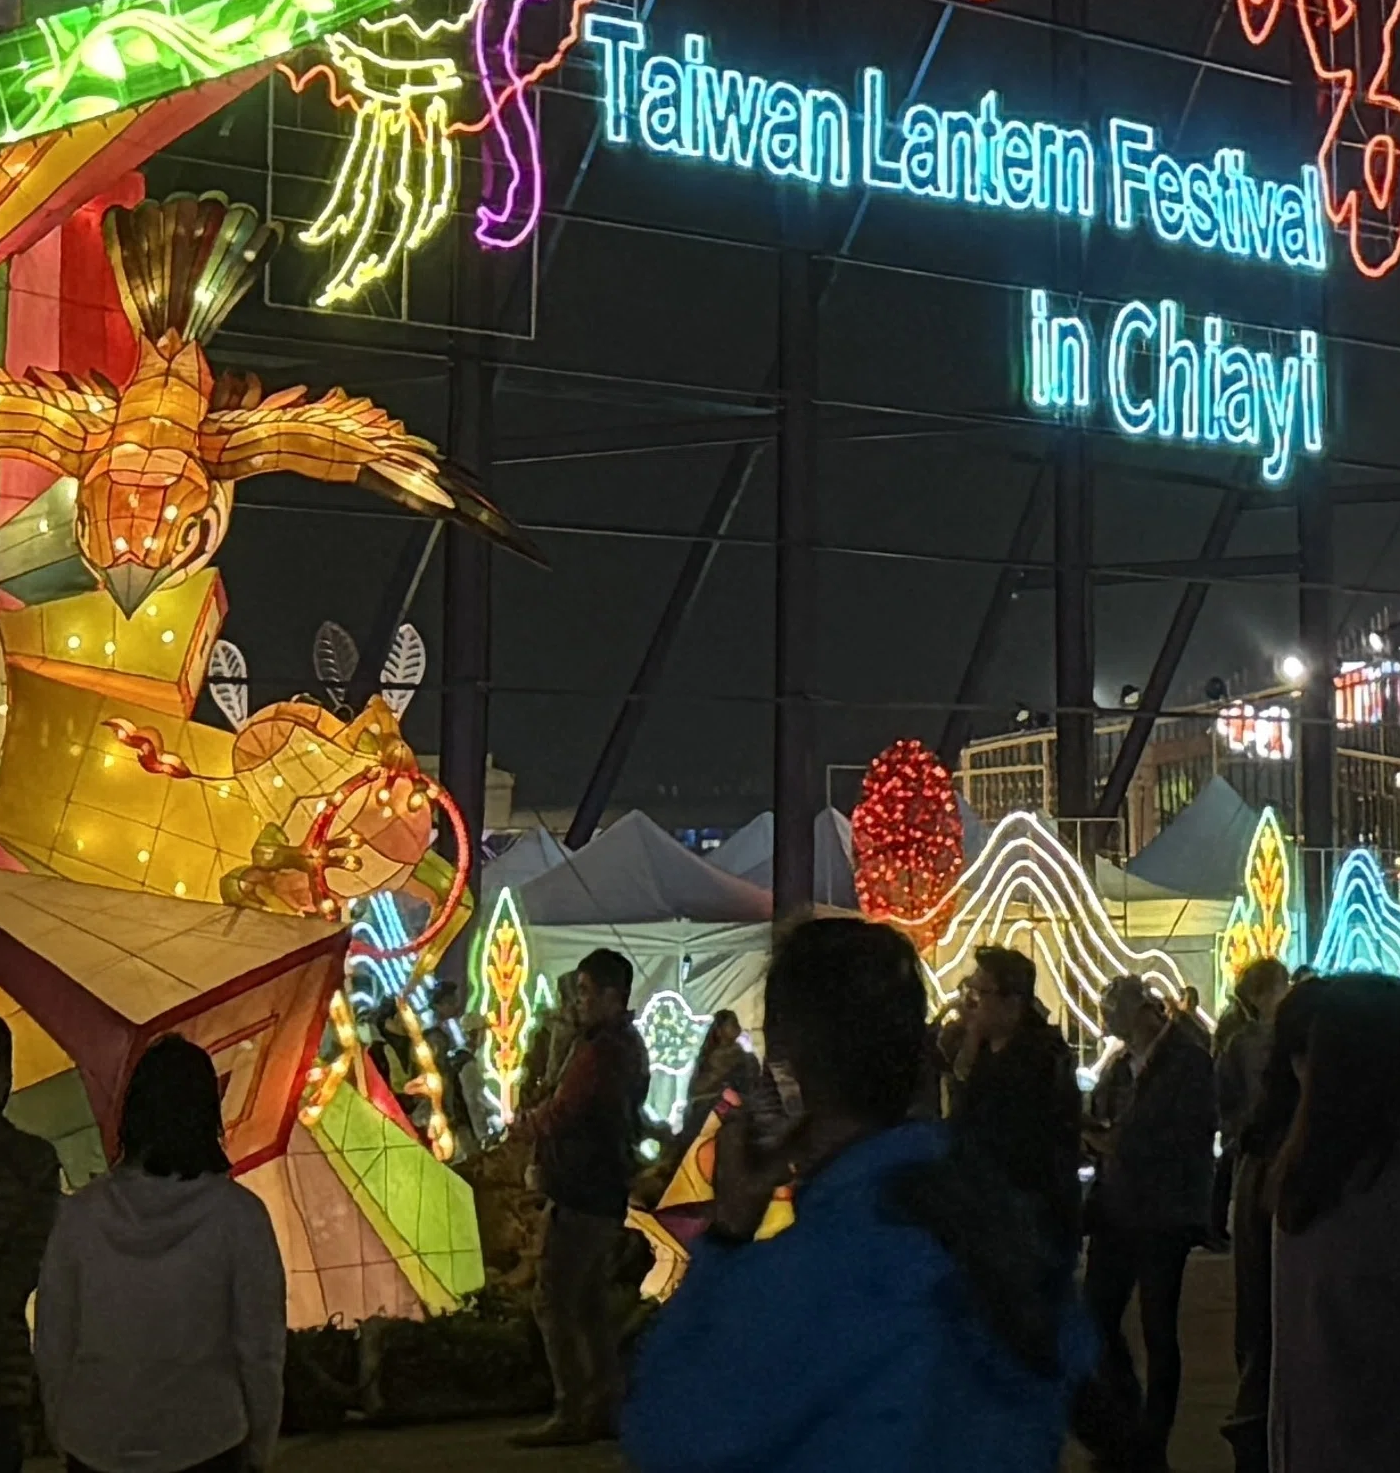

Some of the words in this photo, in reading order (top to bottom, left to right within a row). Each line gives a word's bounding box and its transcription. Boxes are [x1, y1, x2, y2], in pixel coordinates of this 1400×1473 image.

[583, 12, 850, 188] Taiwan
[859, 66, 1096, 218] Lantern
[1108, 116, 1328, 271] Festival
[1029, 288, 1091, 410] in
[1106, 299, 1324, 483] Chiayi
